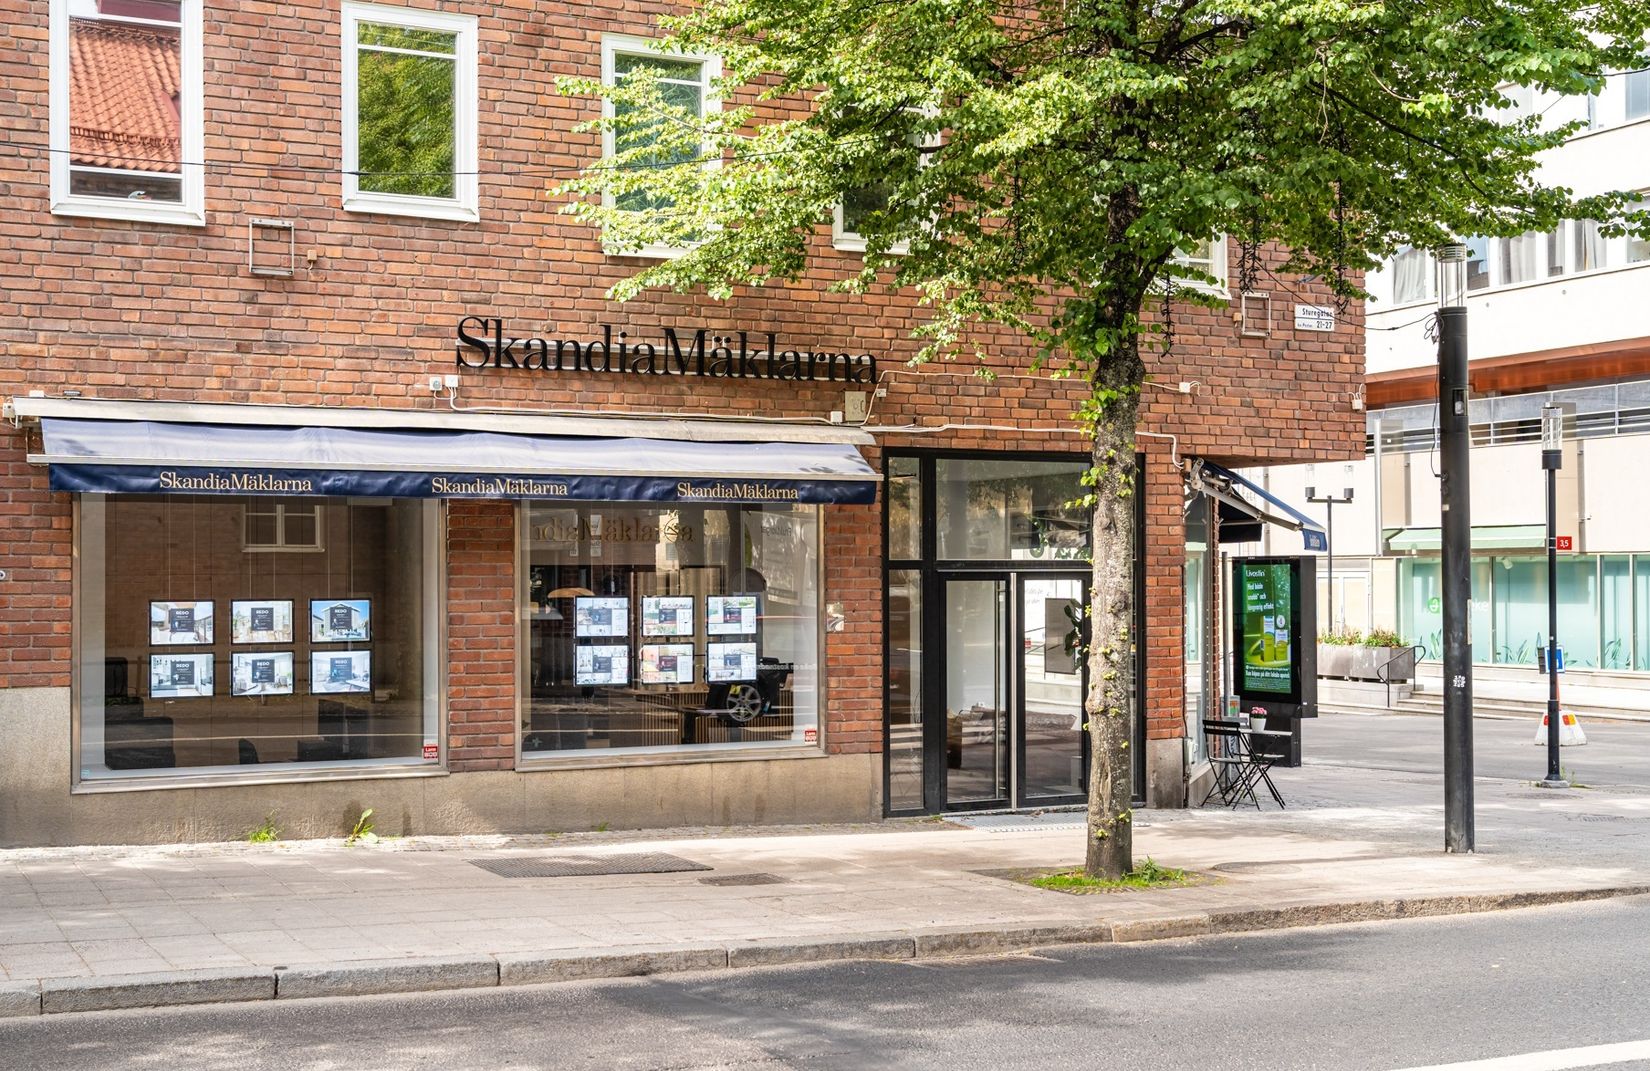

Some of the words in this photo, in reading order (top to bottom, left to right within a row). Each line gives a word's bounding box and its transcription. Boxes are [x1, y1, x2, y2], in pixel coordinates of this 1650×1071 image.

[1316, 321, 1332, 329] 21-27
[456, 316, 878, 384] SkandiaMäklarna
[159, 471, 313, 492] SkandiaMäklarna
[431, 477, 568, 496] SkandiaMäklarna
[677, 482, 799, 499] SkandiaMäklarna
[1559, 539, 1569, 549] 3,5
